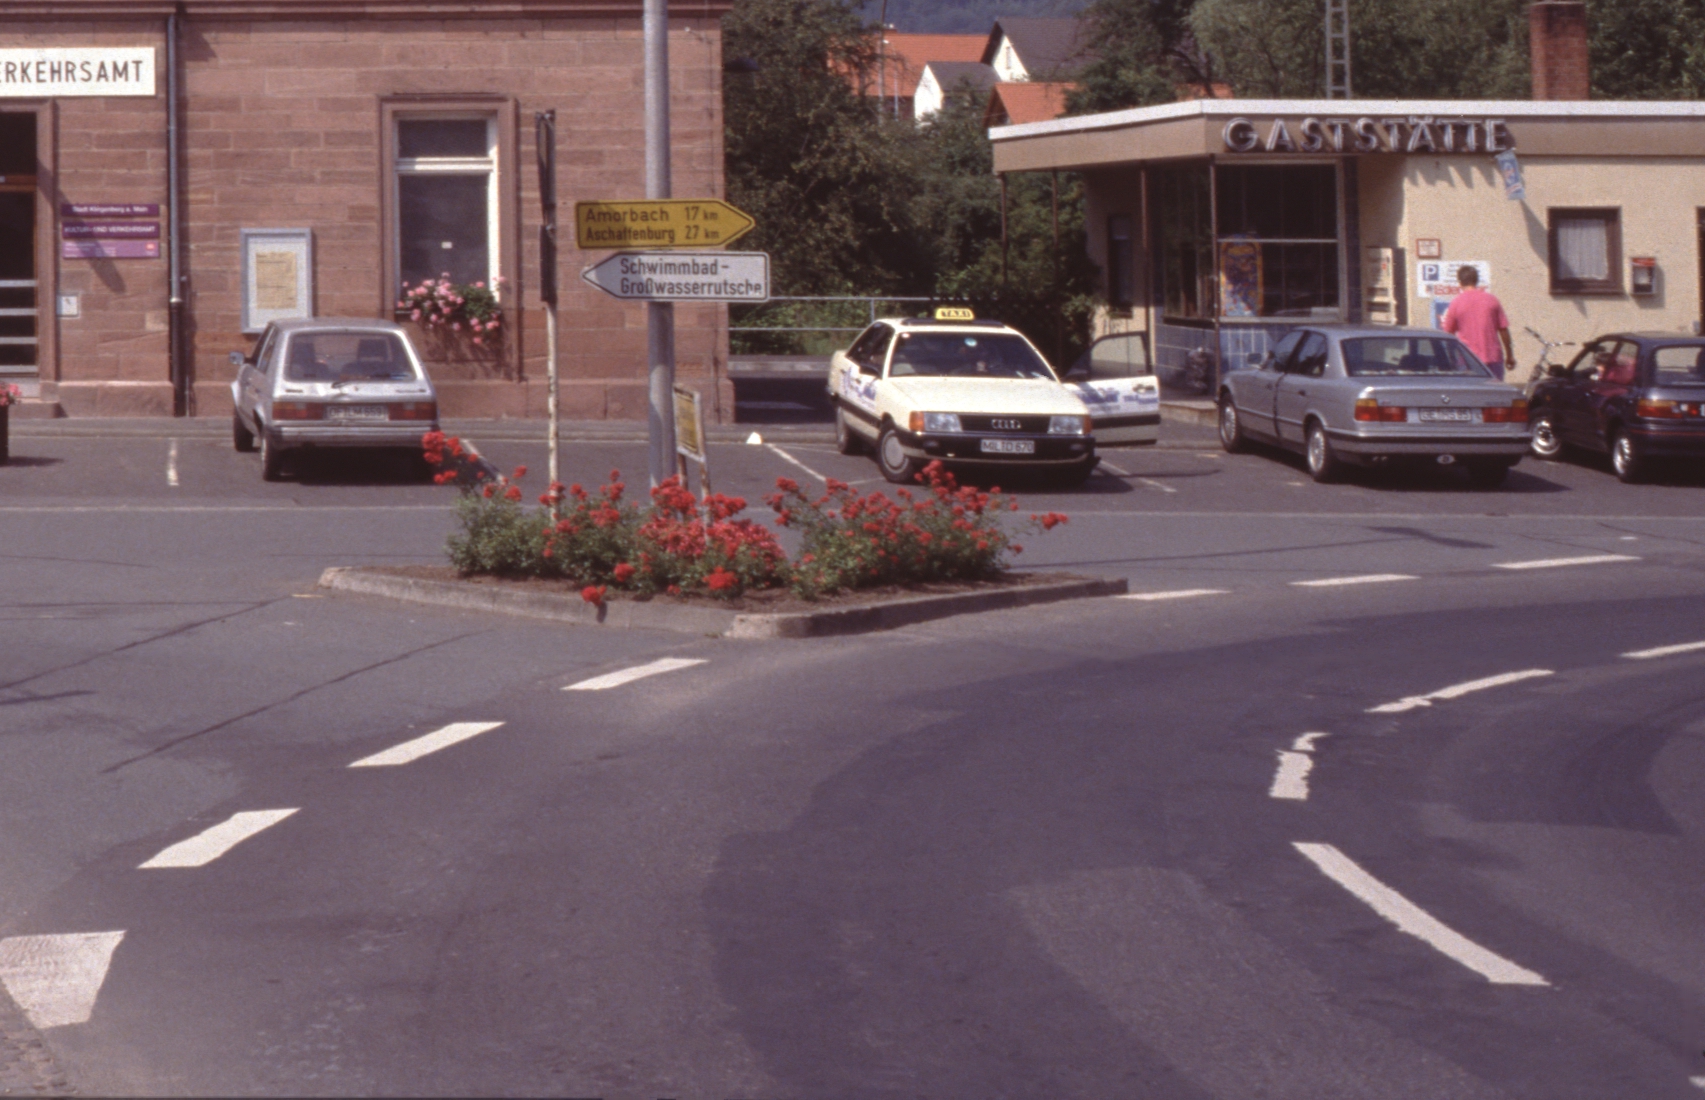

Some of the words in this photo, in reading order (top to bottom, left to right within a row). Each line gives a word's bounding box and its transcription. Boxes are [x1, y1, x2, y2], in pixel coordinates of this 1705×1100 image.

[1222, 115, 1507, 151] GASTSTÄTTE
[585, 208, 670, 223] Amorbach
[685, 206, 700, 221] 17
[703, 209, 718, 221] km
[586, 227, 675, 243] Aschaffenburg
[685, 225, 700, 240] 27
[704, 228, 719, 239] km
[620, 277, 761, 295] Großwasserrutsche
